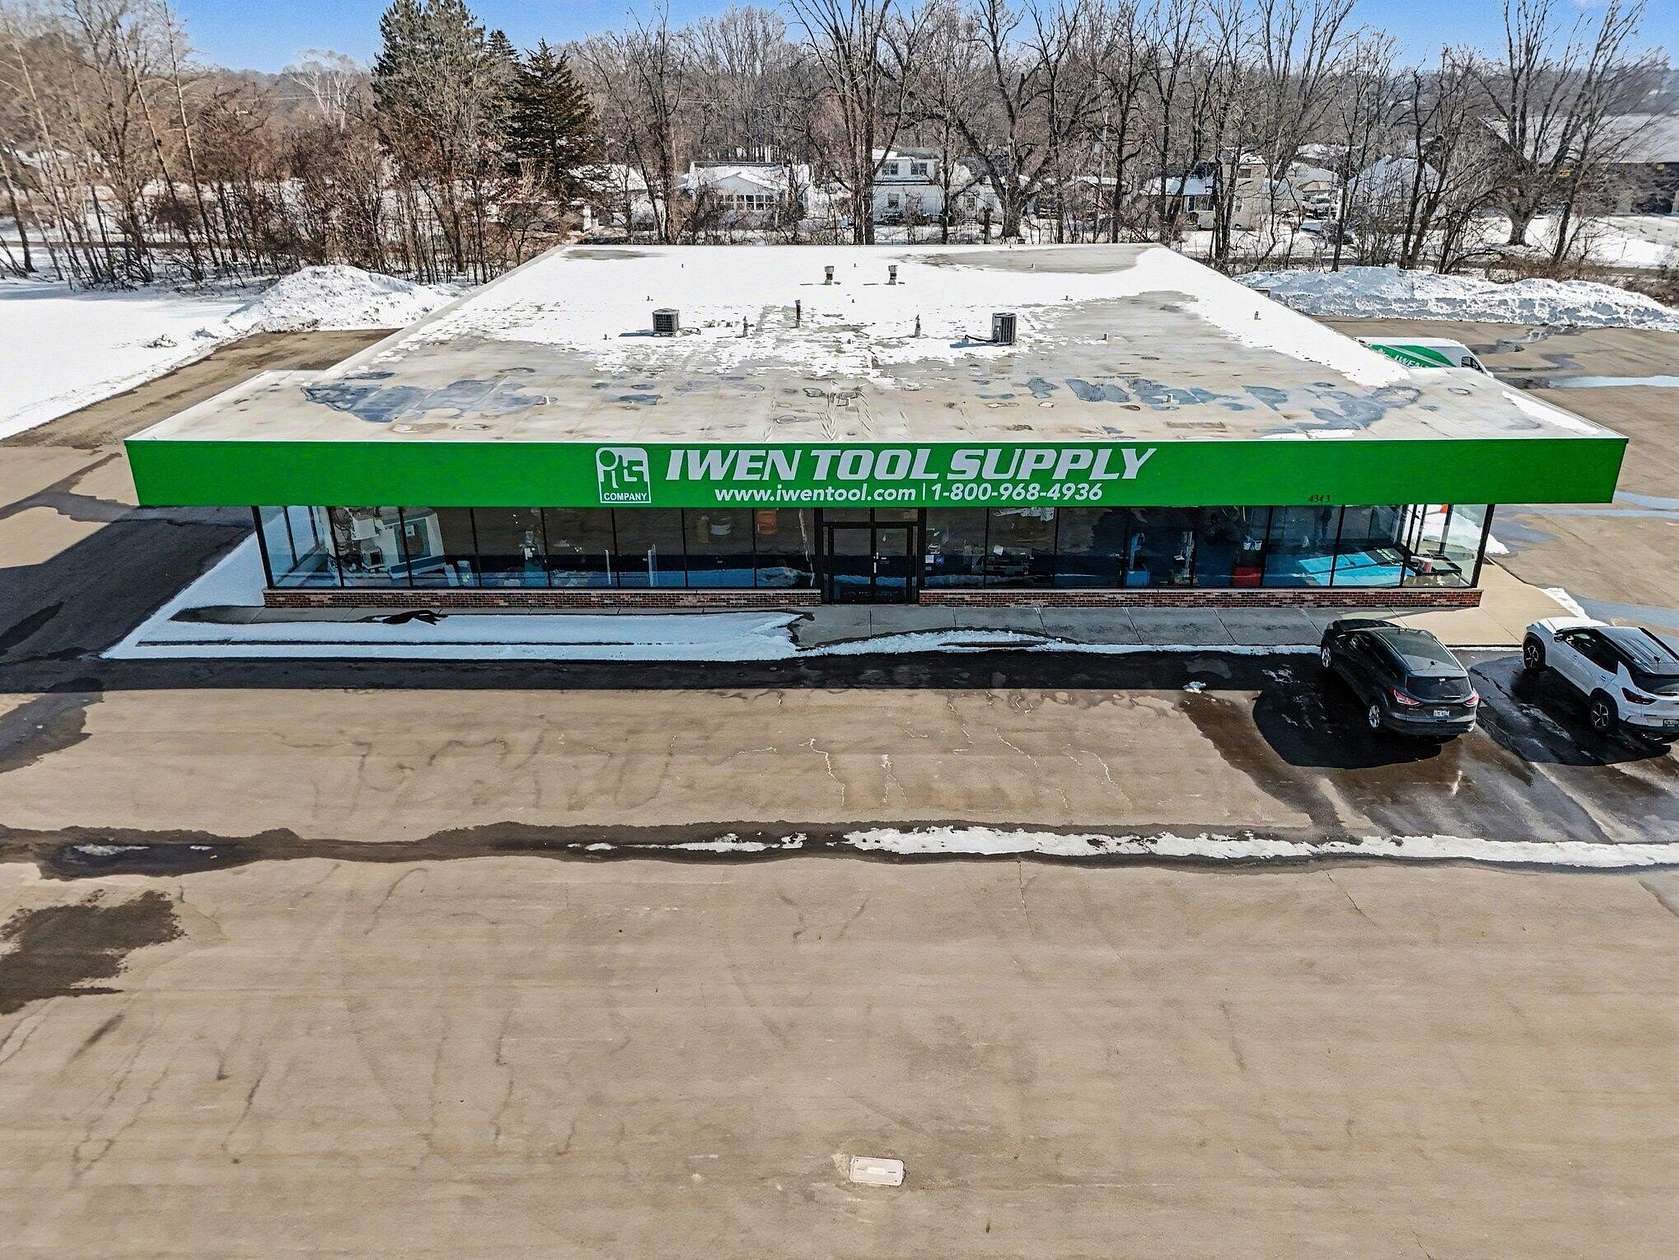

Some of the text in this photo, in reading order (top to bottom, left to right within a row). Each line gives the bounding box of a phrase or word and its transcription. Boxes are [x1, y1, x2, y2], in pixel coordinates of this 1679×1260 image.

[665, 448, 1158, 481] IWEN TOOL SUPPLY
[603, 492, 648, 501] COMPANY
[714, 482, 1103, 502] www.iwentool.com 1-800-968-4936
